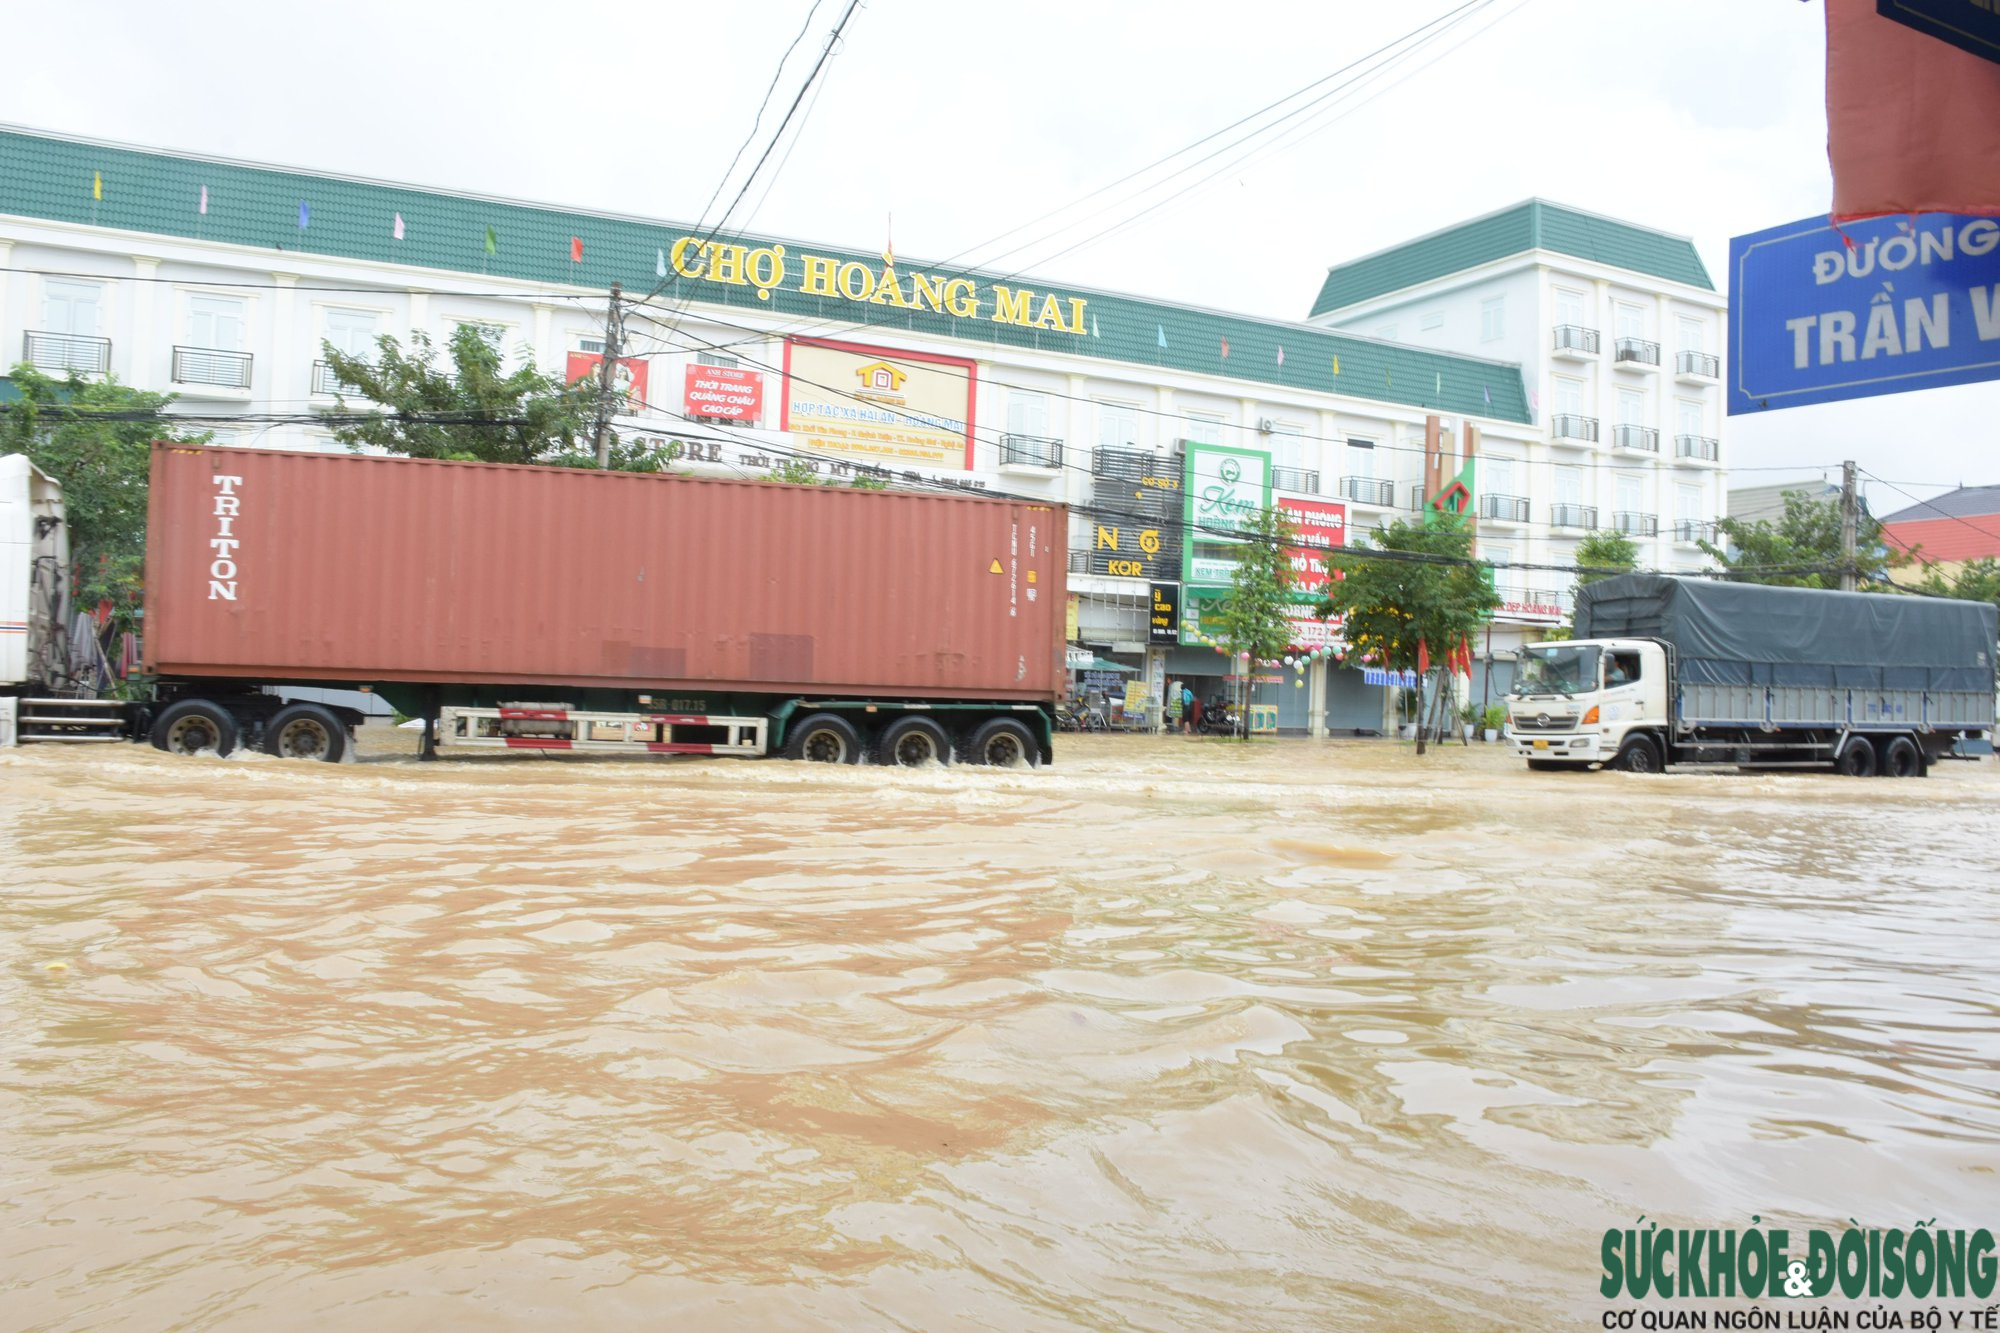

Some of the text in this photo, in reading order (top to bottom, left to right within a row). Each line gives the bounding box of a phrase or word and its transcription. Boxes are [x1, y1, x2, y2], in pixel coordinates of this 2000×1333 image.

[1813, 219, 2000, 286] ĐƯỜNG
[670, 236, 1088, 335] CHỢ HOÀNG MAI
[1785, 281, 1950, 370] TRẦN
[695, 379, 753, 394] THỜI TRANG
[689, 391, 756, 406] QUẢNG CHÂU
[701, 404, 744, 415] CAO CẤP
[943, 418, 964, 432] MAI
[739, 452, 770, 468] THỜI
[1200, 485, 1256, 516] Kem
[1305, 508, 1343, 528] PHÒNG
[207, 474, 243, 601] TRITON
[1307, 530, 1330, 548] VẤN
